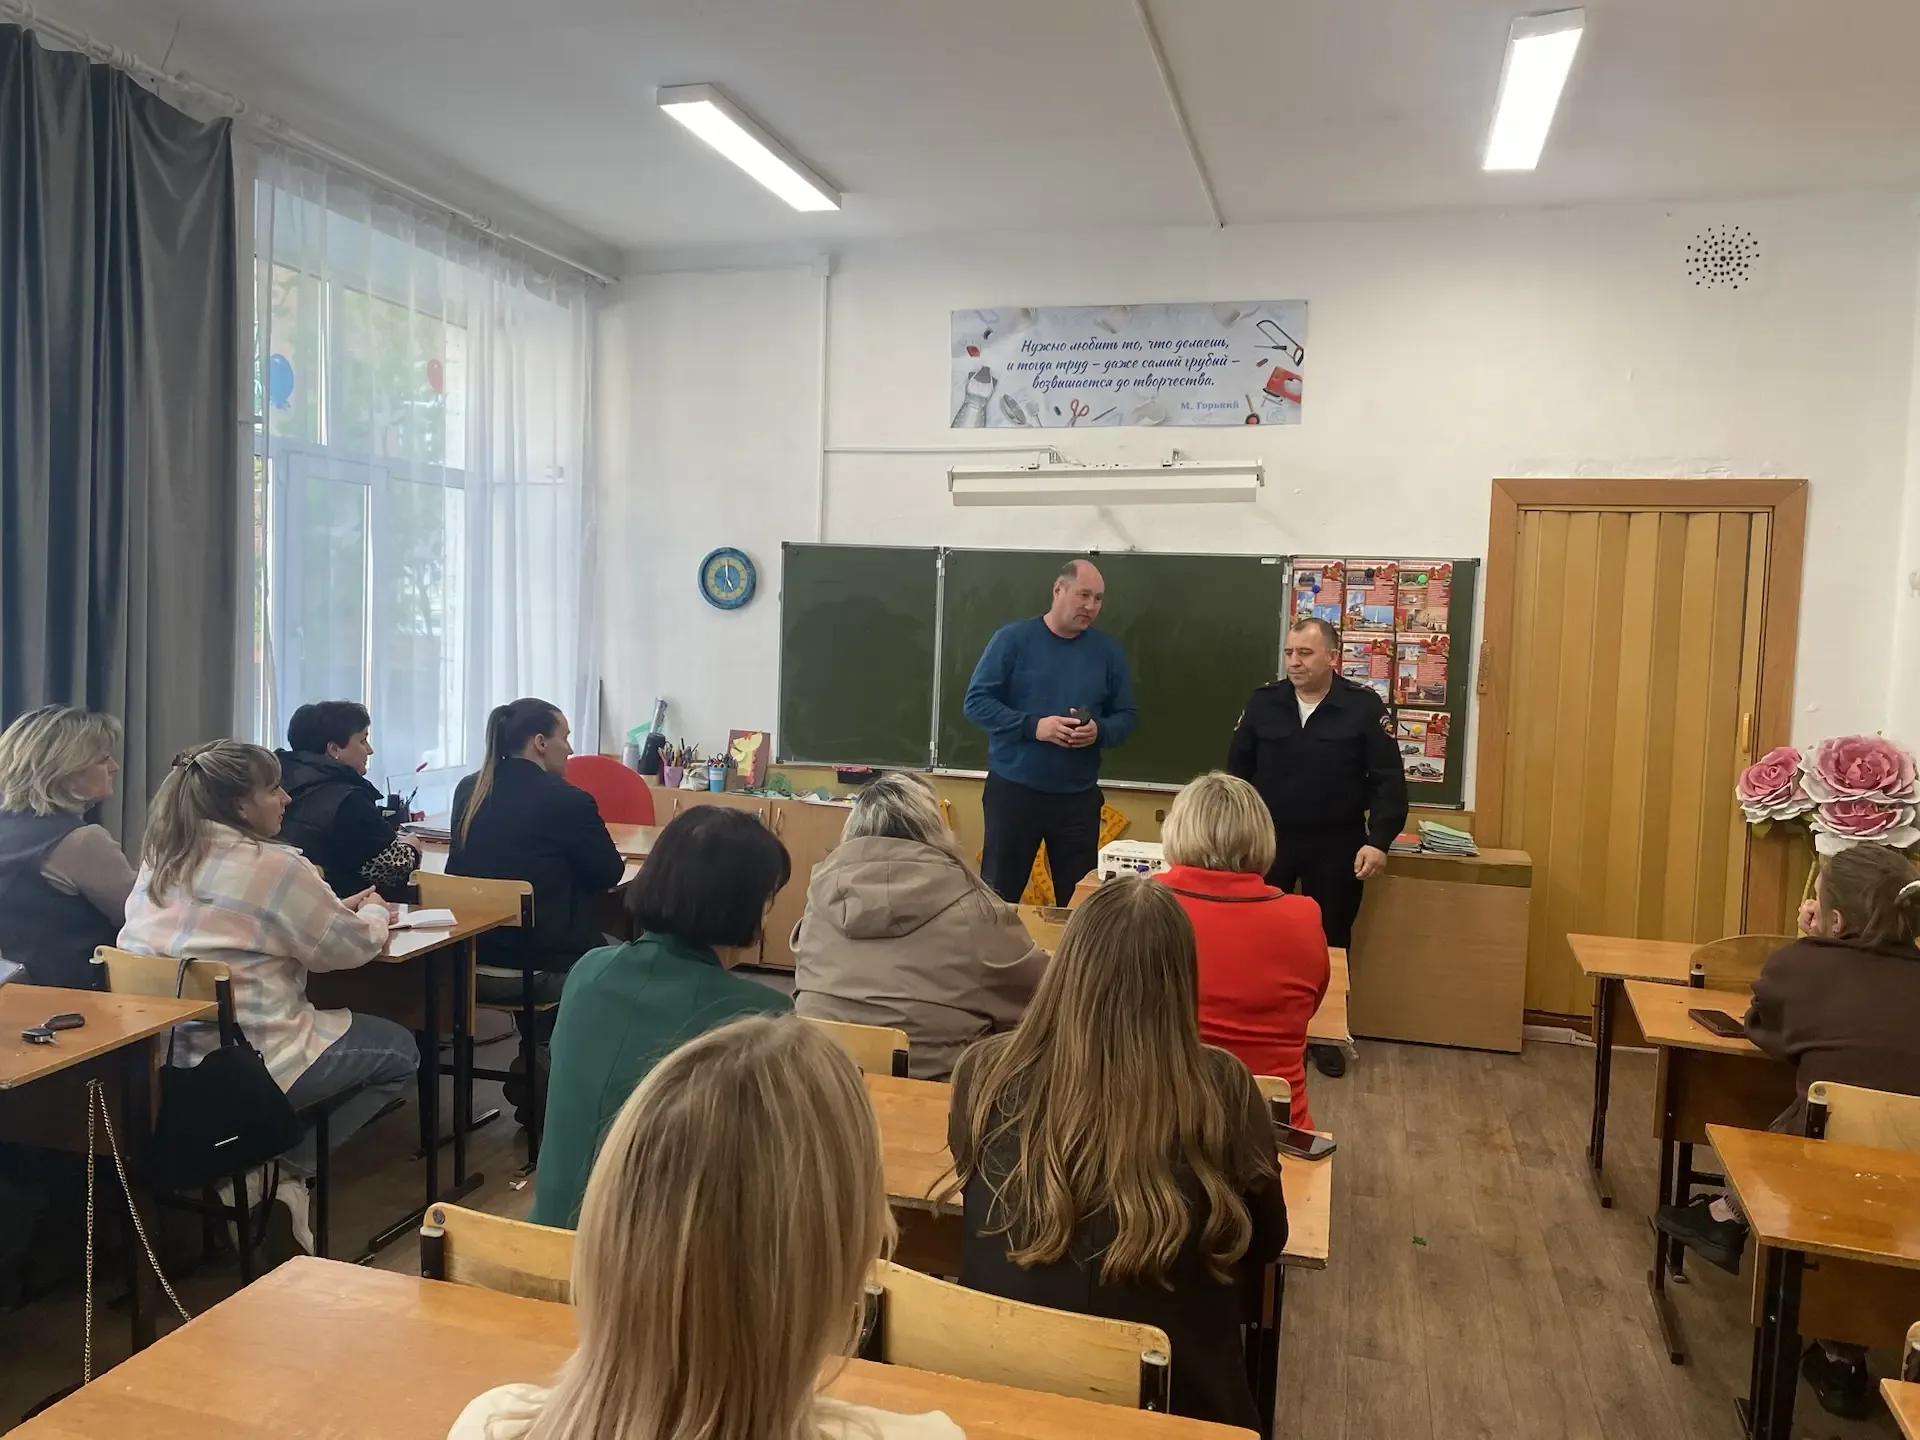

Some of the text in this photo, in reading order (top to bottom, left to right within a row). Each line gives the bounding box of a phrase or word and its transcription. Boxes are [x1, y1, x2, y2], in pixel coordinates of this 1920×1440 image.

[1021, 336, 1229, 357] Нужно любить то, что делаешь,
[1006, 361, 1014, 371] и
[1017, 360, 1052, 375] тогда
[1056, 360, 1089, 375] труд
[1102, 359, 1139, 374] даже
[1115, 378, 1130, 393] до
[1133, 372, 1215, 392] творчества.
[1180, 400, 1240, 411] М. Горький
